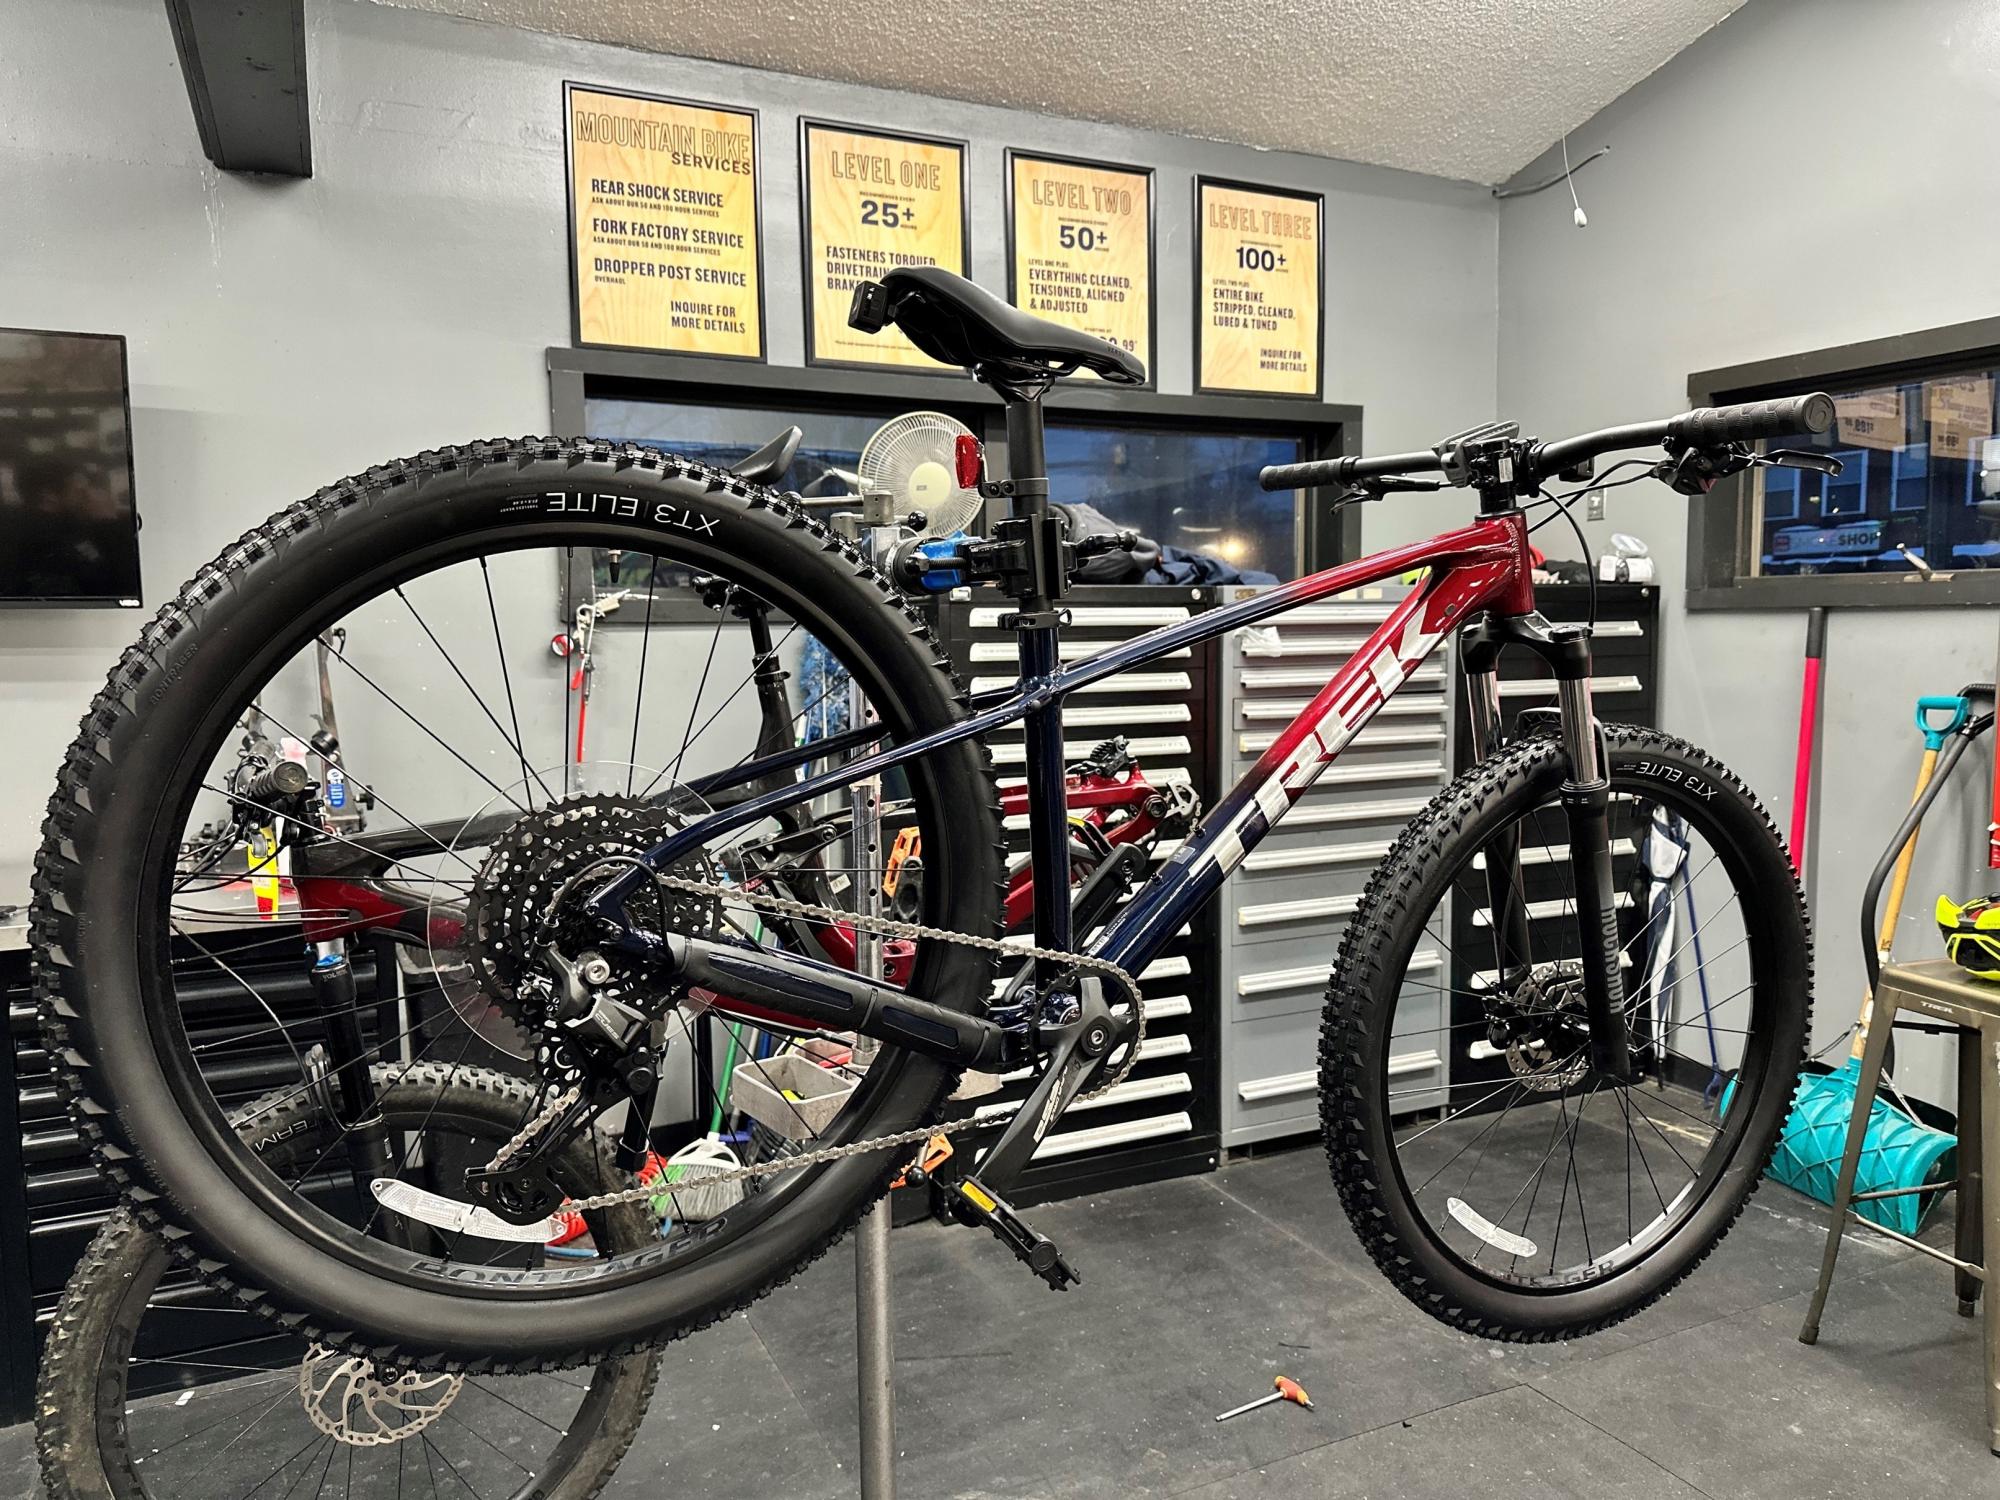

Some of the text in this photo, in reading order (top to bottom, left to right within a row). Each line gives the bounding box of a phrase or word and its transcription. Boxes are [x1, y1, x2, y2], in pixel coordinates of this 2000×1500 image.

[576, 111, 750, 164] MOUNTAIN BIKE
[671, 151, 751, 176] SERVICES
[832, 150, 941, 191] LEVEL ONE
[591, 178, 724, 208] REAR SHOCK SERVICE
[1032, 179, 1131, 215] LEVEL TWO
[605, 198, 625, 207] ABOUT
[649, 203, 661, 211] AND
[692, 208, 719, 218] SERVICES
[861, 199, 915, 228] 25+
[1209, 203, 1312, 240] LEVEL THREE
[593, 218, 744, 249] FORK FACTORY SERVICE
[1059, 225, 1107, 251] 50+
[607, 238, 626, 246] ABOUT
[650, 242, 662, 250] AND
[693, 247, 721, 256] SERVICES
[826, 245, 886, 264] FASTENERS
[1236, 246, 1286, 272] 100+
[594, 257, 747, 287] DROPPER POST SERVICE
[594, 275, 626, 285] OVERHAUL
[1029, 268, 1133, 290] EVERYTHING CLEANED,
[1029, 283, 1125, 303] TENSIONED, ALIGNED
[1213, 288, 1264, 303] ENTIRE BIKE
[671, 301, 736, 318] INQUIRE FOR
[1030, 298, 1088, 313] & ADJUSTED
[1213, 302, 1296, 320] STRIPPED, CLEANED,
[671, 316, 746, 334] MORE DETAILS
[1213, 315, 1277, 331] LUBED & TUNED
[1260, 348, 1302, 360] INQUIRE FOR
[1260, 361, 1307, 373] MORE DETAILS
[546, 492, 720, 537] XT3 ELITE
[1838, 533, 1878, 546] SHOP
[1188, 602, 1444, 880] TREK
[1636, 761, 1718, 801] XT3 ELITE
[407, 1215, 729, 1291] BONTRAGER
